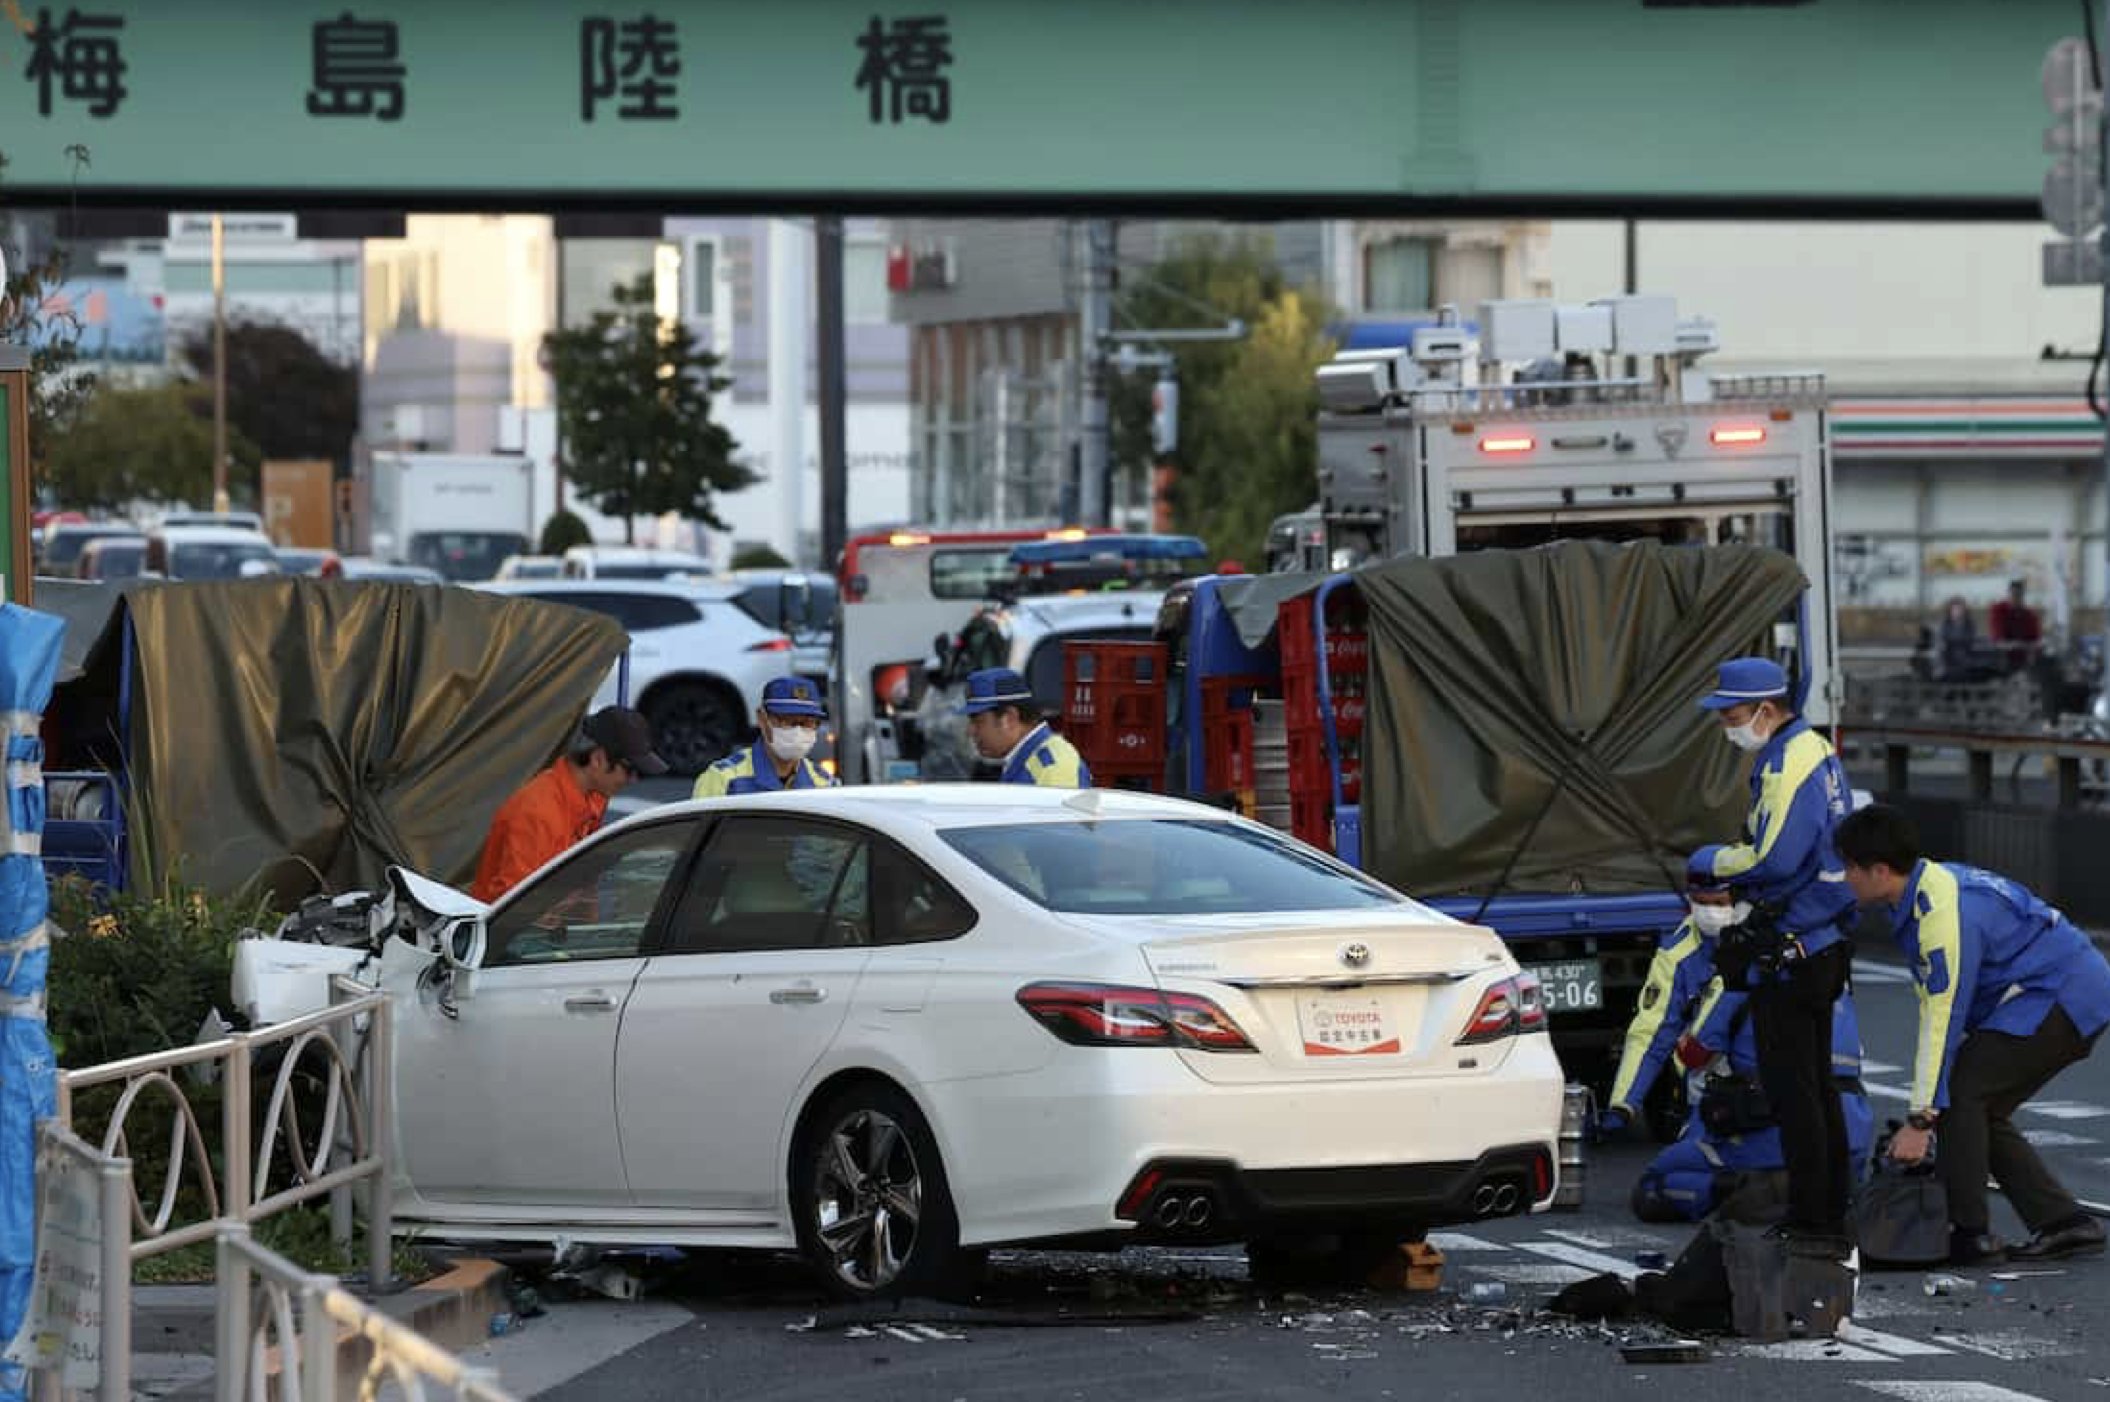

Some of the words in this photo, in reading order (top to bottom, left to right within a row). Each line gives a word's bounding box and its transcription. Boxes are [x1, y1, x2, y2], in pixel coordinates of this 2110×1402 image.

[24, 12, 955, 124] 梅島陸橋
[1541, 979, 1598, 1009] 5-06
[1335, 1011, 1381, 1025] TOYOTA
